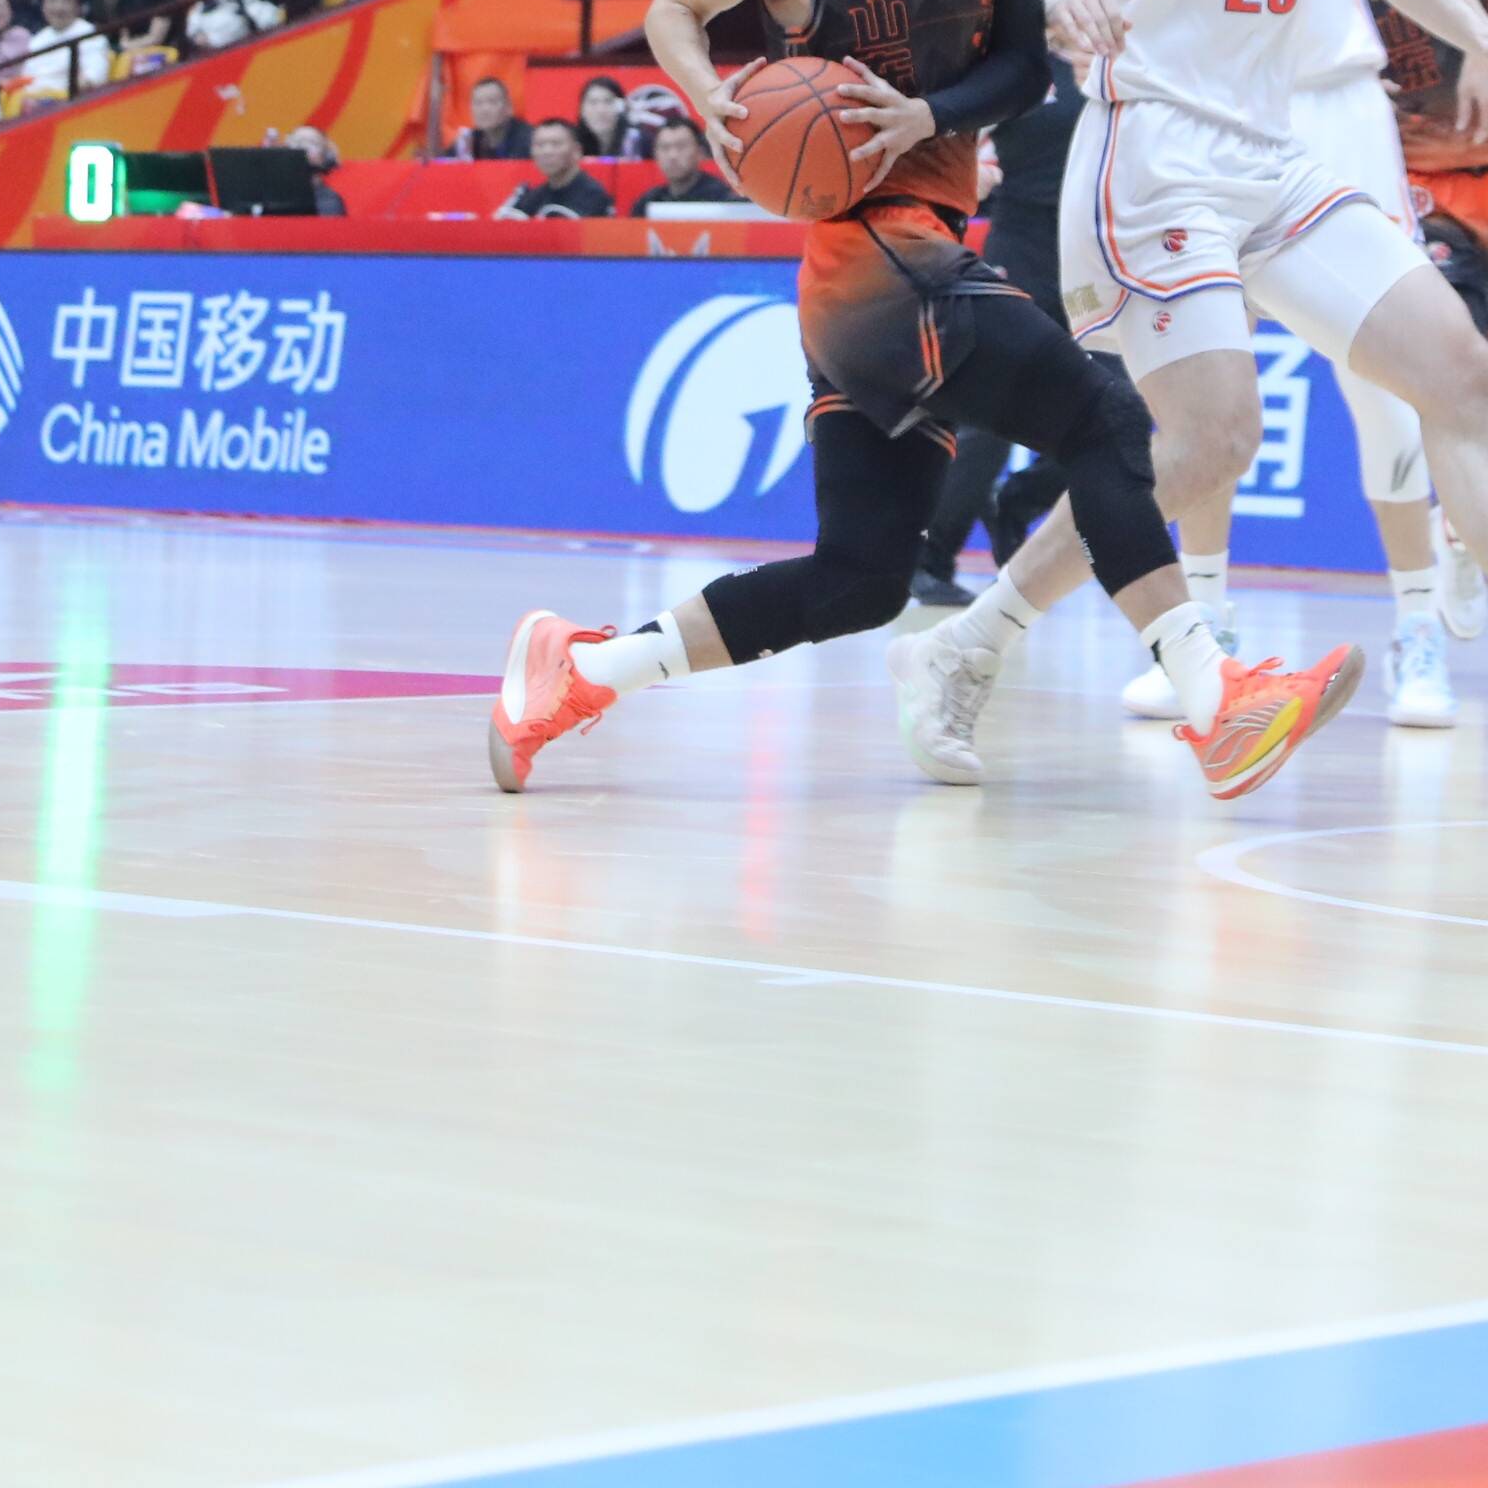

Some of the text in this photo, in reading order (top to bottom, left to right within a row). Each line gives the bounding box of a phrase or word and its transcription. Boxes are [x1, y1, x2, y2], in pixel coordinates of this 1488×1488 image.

[69, 145, 114, 222] 0
[52, 287, 346, 394] 中国移动
[41, 403, 330, 474] China Mobile
